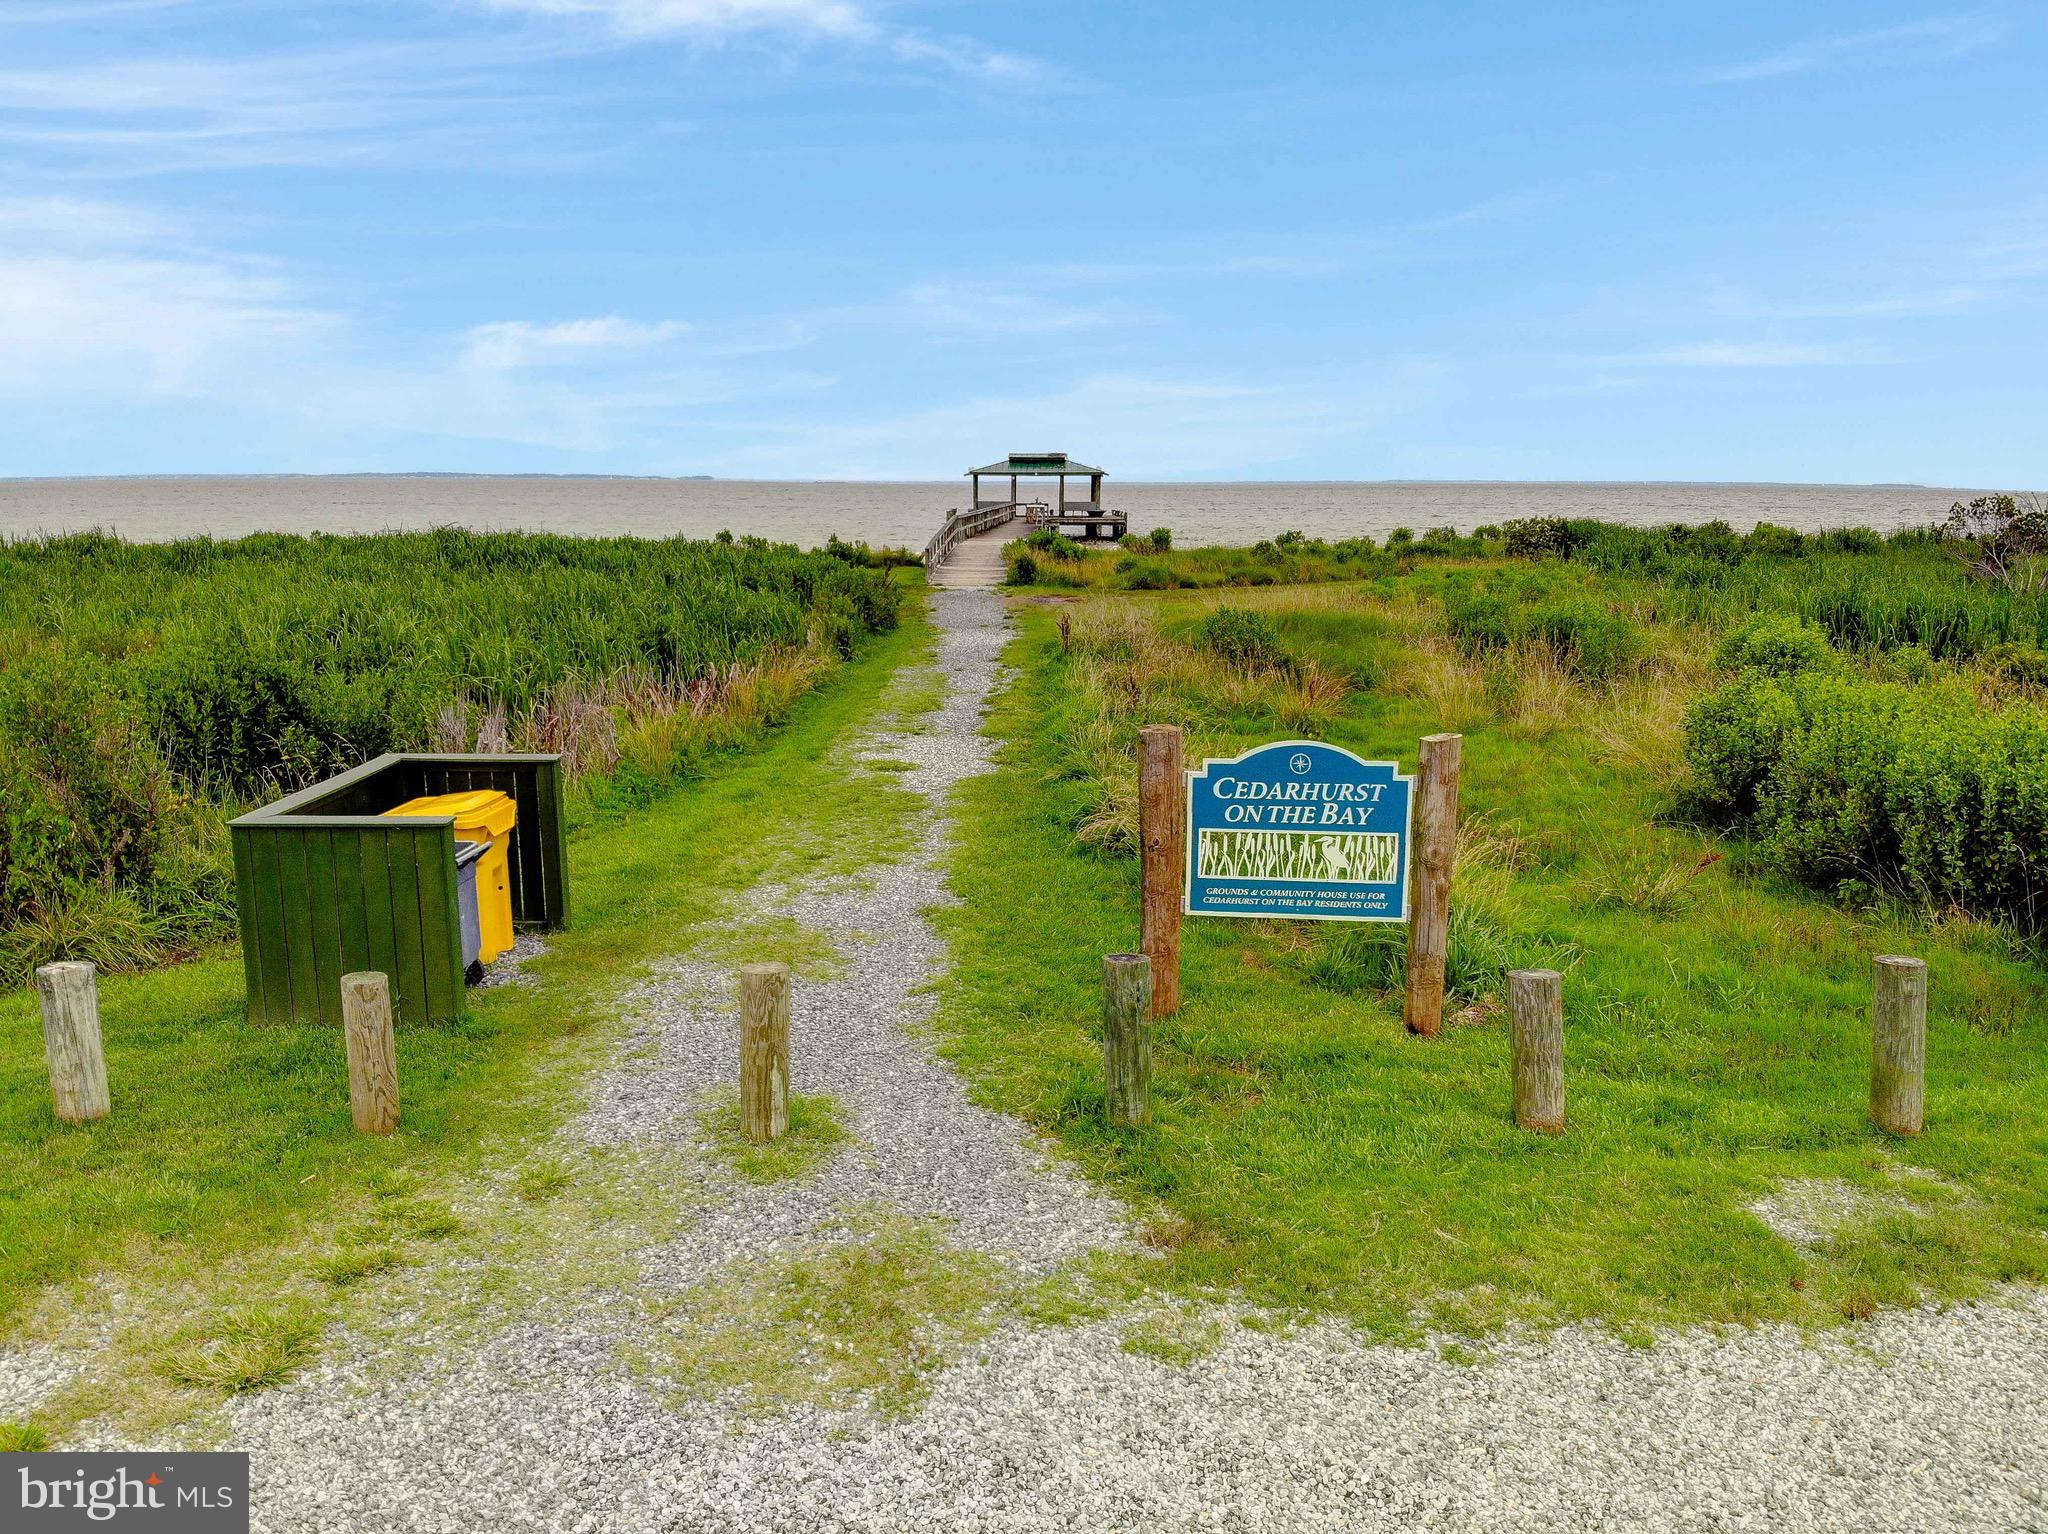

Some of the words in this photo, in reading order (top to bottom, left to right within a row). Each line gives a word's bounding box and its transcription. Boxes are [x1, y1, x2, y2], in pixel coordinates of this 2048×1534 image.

[1213, 777, 1387, 802] CEDARHURST
[1224, 805, 1264, 823] ON
[1268, 806, 1317, 824] THE
[1319, 802, 1374, 825] BAY
[1203, 896, 1259, 904] CEDARHURST
[1314, 900, 1362, 908] RESIDENTS
[1260, 889, 1315, 898] COMMUNITY
[1317, 891, 1348, 899] HOUSE
